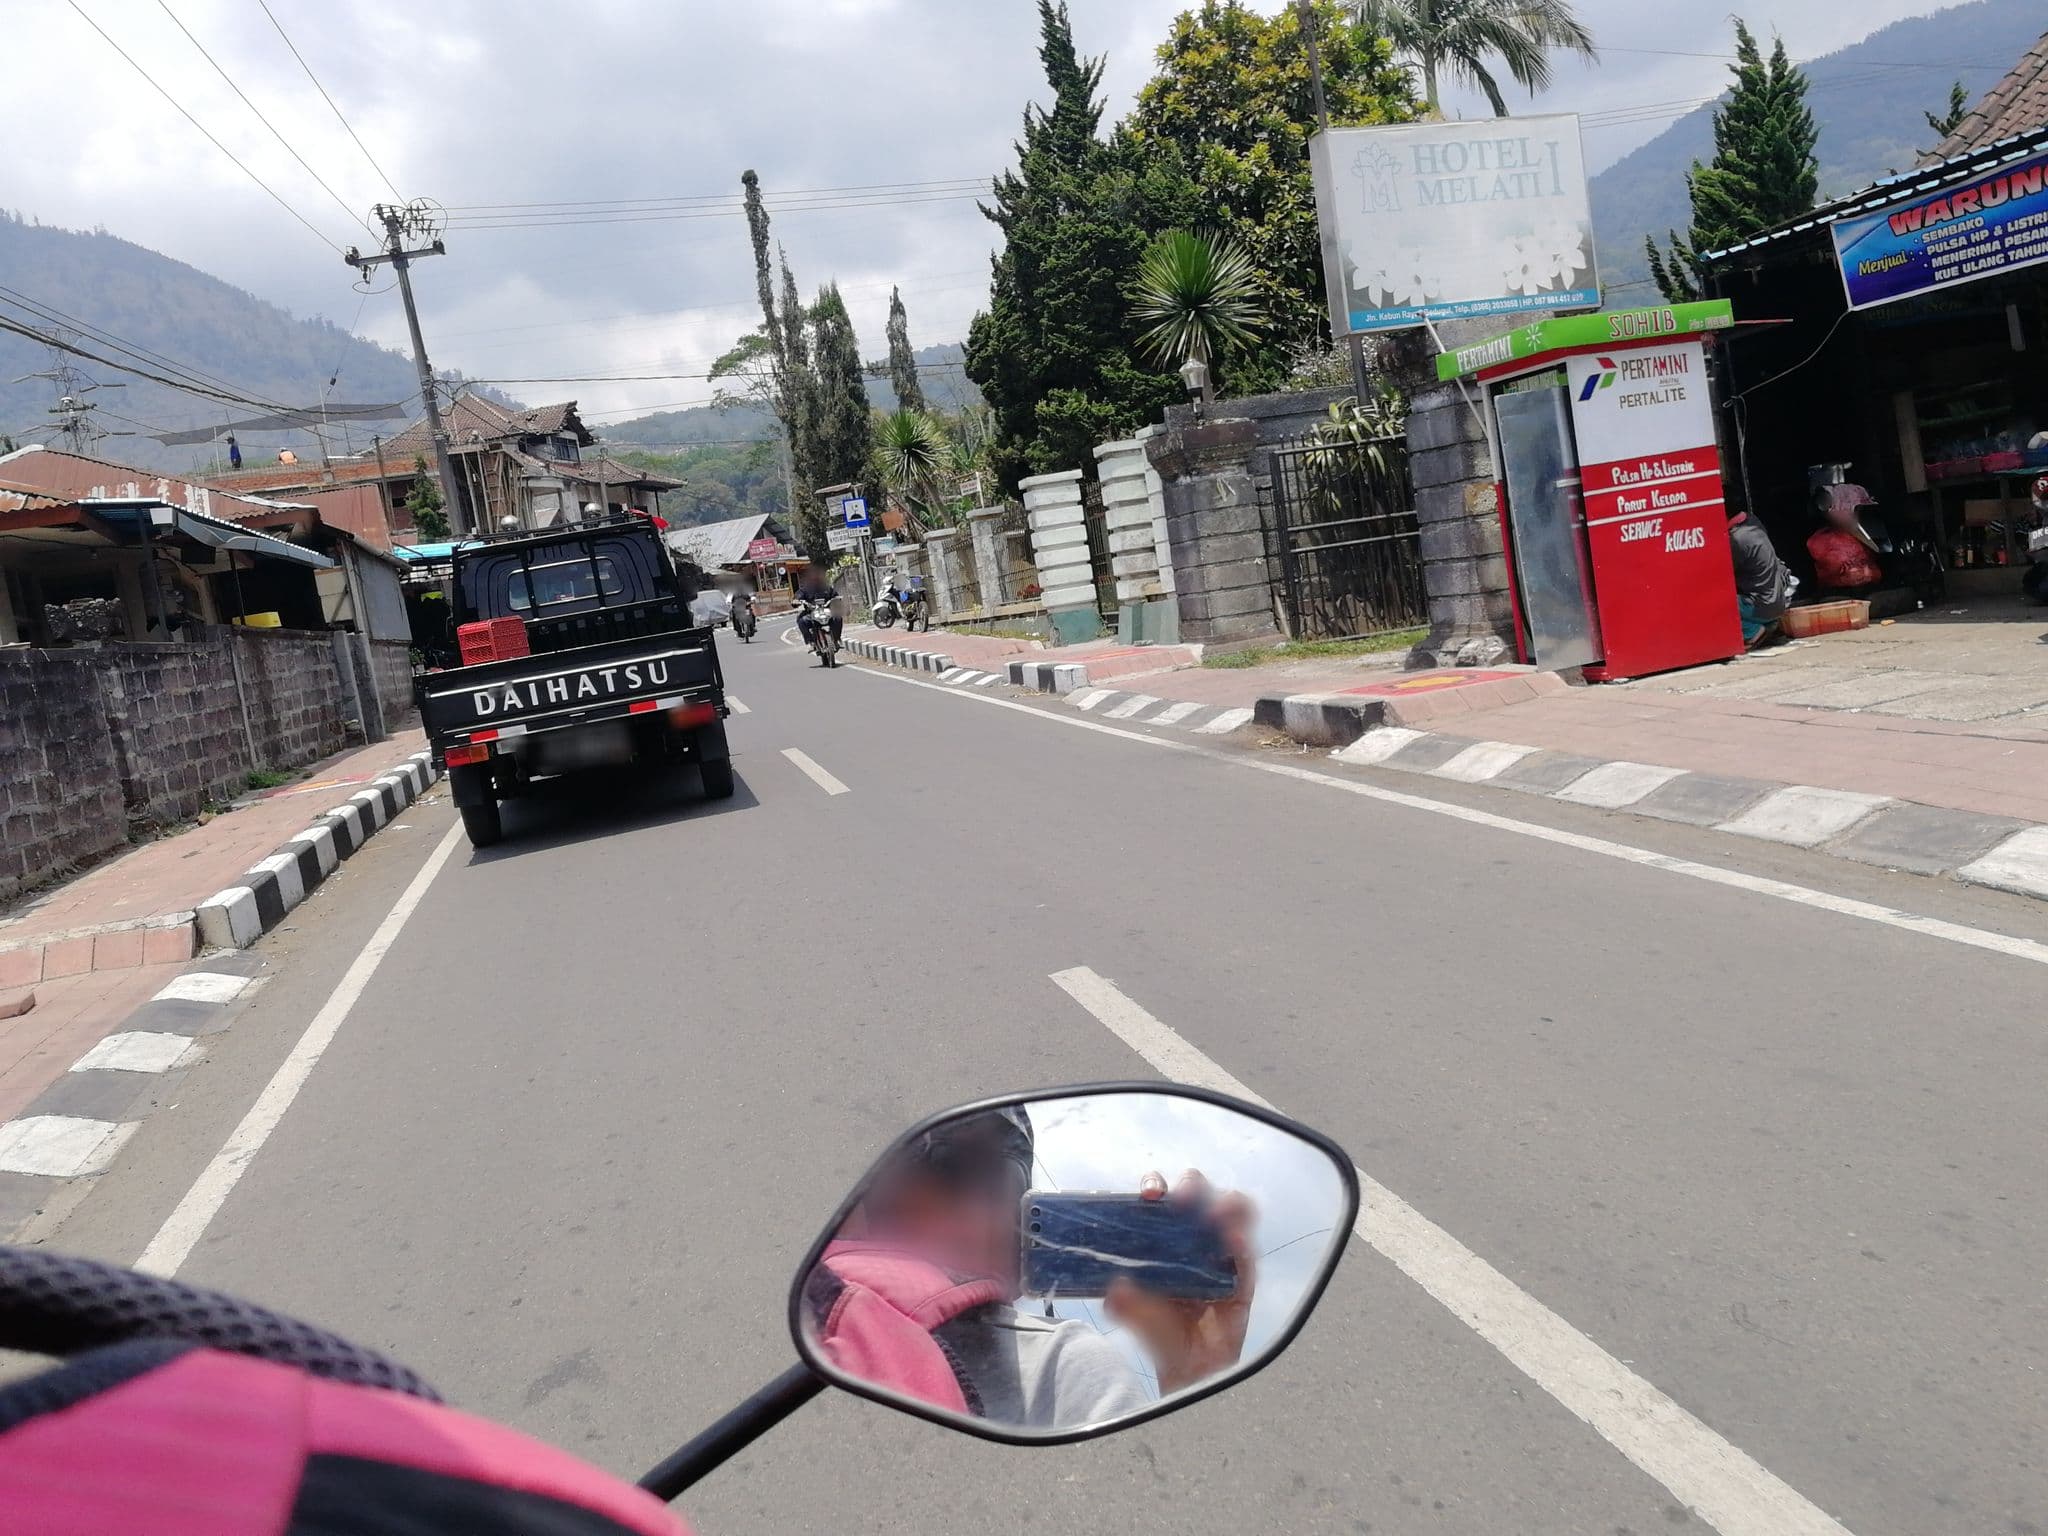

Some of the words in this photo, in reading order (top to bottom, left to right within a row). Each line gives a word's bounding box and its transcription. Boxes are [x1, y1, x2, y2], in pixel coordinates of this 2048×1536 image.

[1409, 137, 1541, 175] HOTEL
[1416, 171, 1546, 207] MELATI
[1922, 216, 1984, 243] SEMBAKO
[1927, 235, 1968, 256] PULSA
[1970, 229, 1989, 243] HP
[1993, 225, 2003, 237] &
[1859, 250, 1908, 276] Menjual
[1931, 240, 2001, 268] MENERIMA
[1934, 265, 1960, 281] KUE
[1962, 253, 2005, 274] ULANG
[1608, 308, 1676, 338] SOHIB
[1456, 335, 1513, 372] PERTAMINI
[1621, 353, 1688, 381] PERTAMINI
[1619, 387, 1686, 409] PERTALITE
[1653, 462, 1663, 478] &
[473, 660, 669, 716] DAIHATSU
